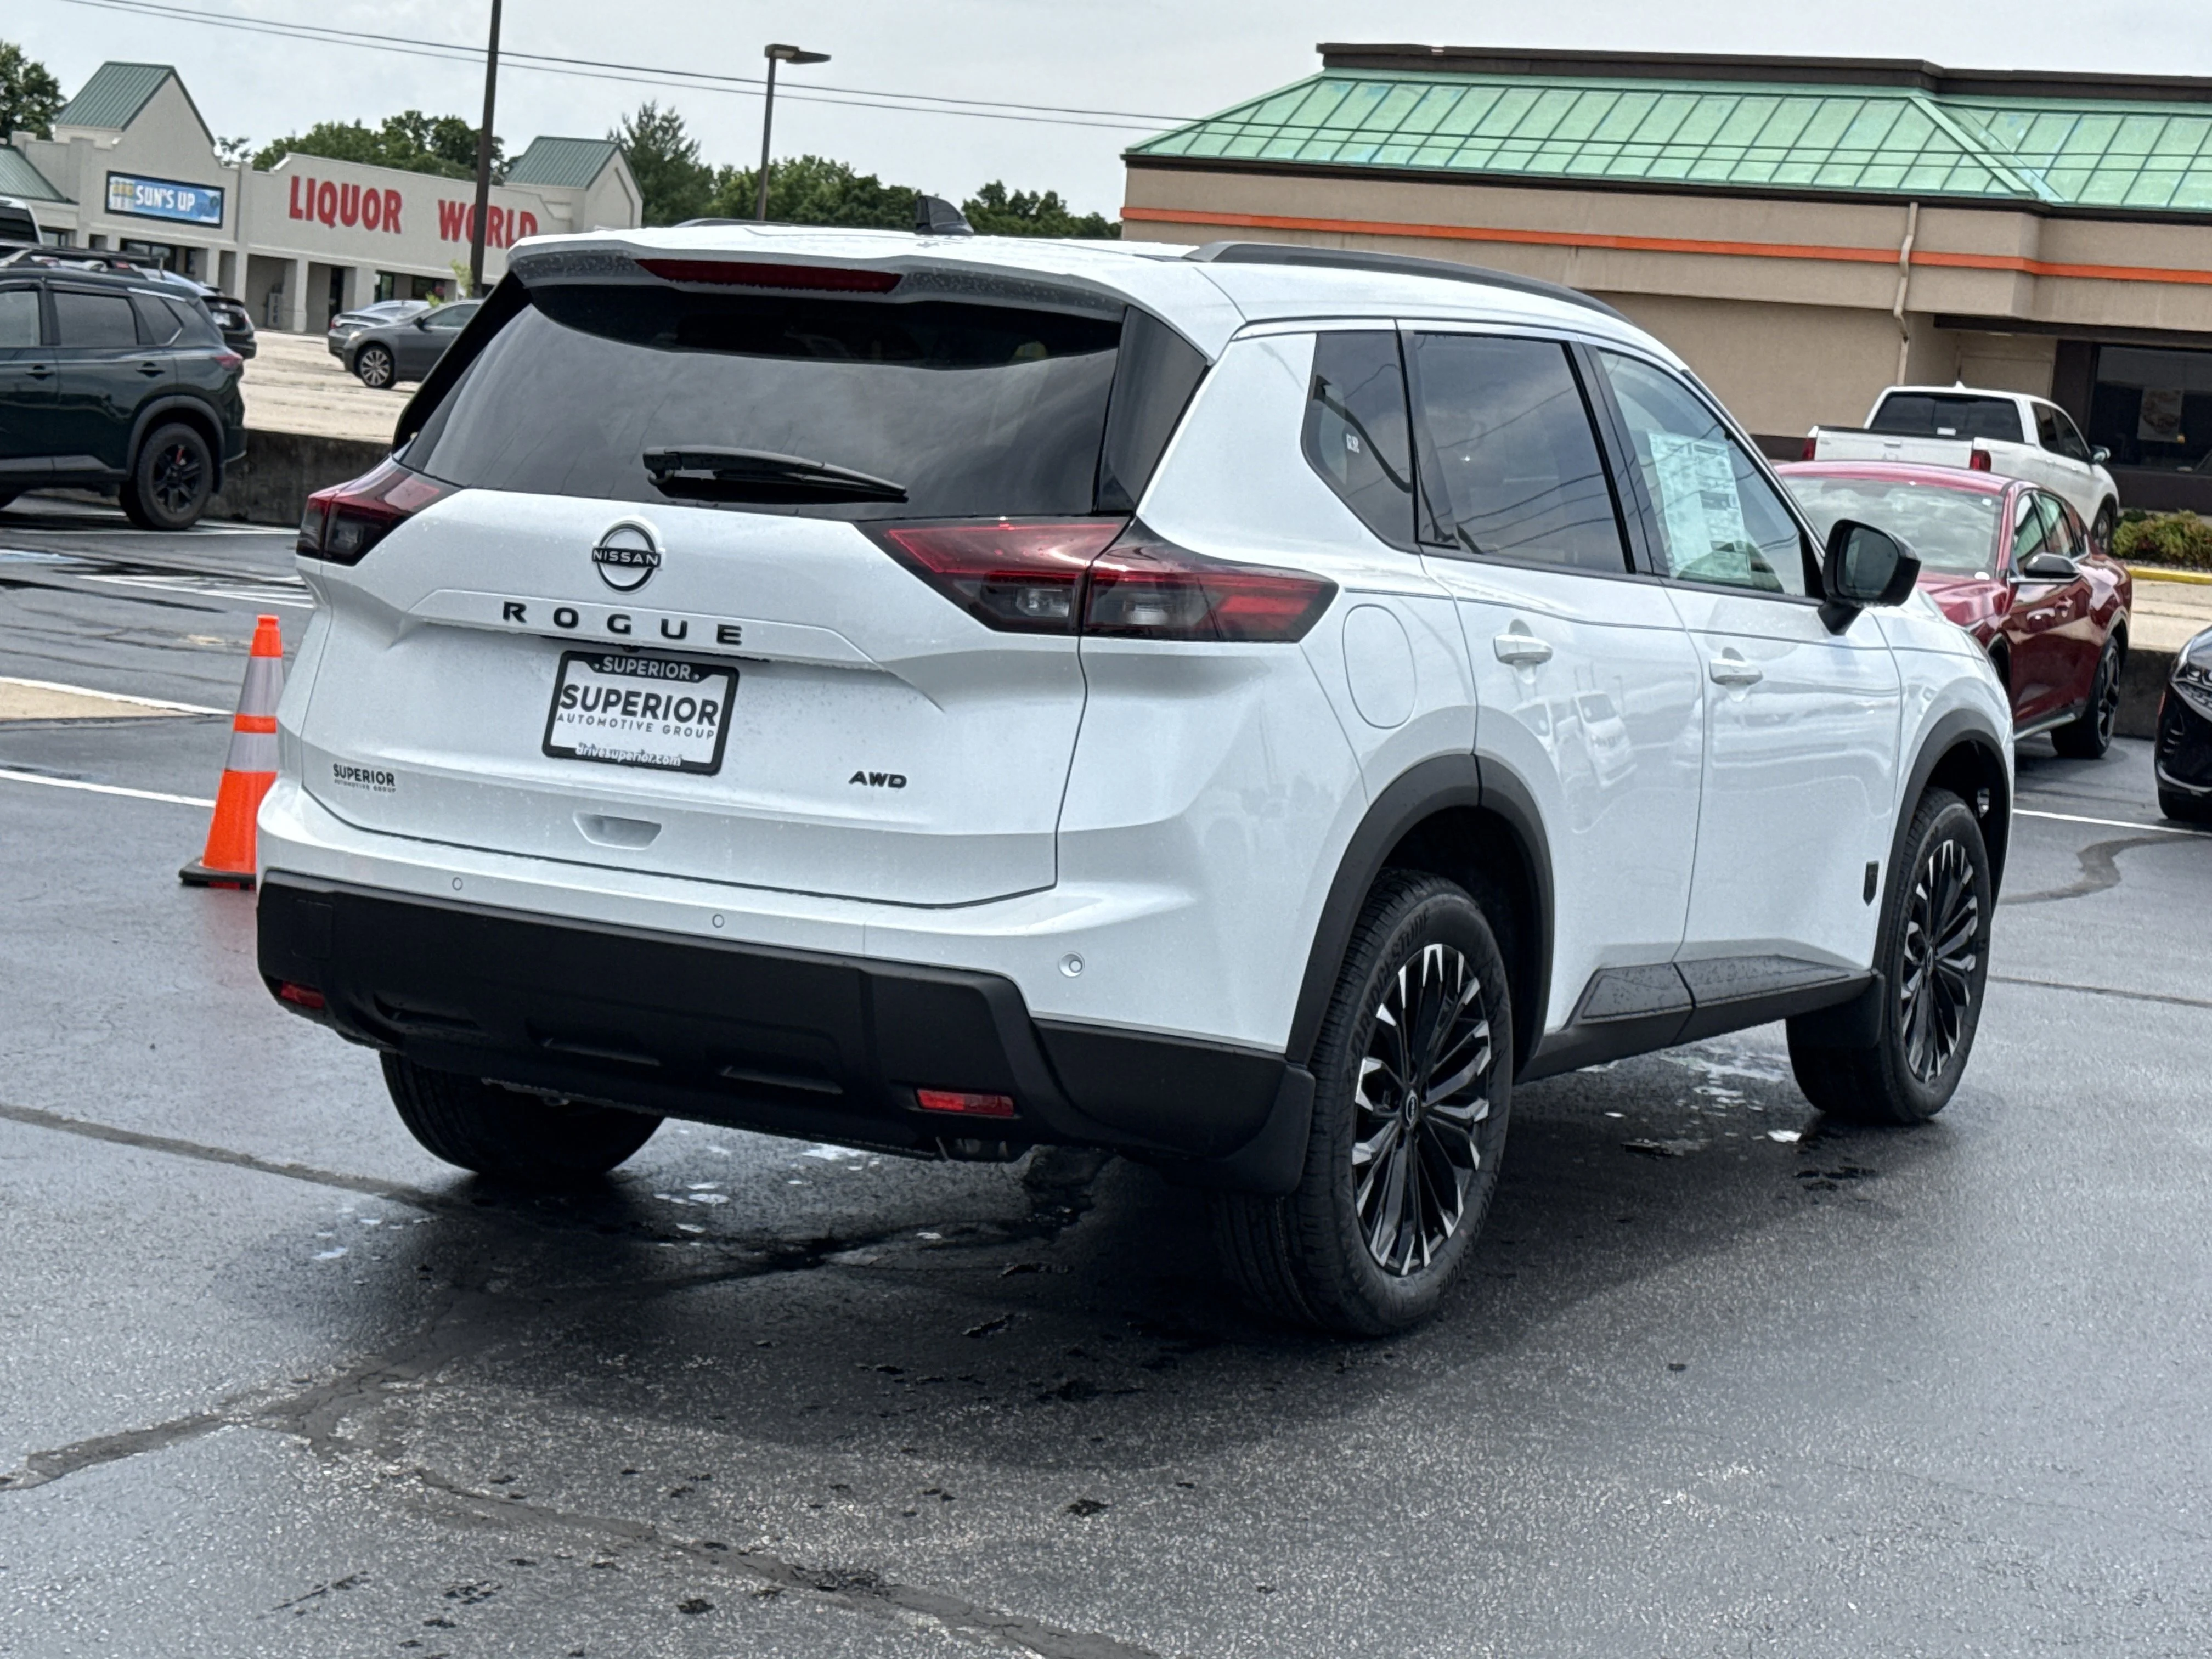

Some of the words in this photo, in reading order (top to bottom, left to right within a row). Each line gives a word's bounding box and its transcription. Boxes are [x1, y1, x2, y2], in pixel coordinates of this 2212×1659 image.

[136, 184, 174, 208] SUN'S
[177, 191, 195, 211] UP
[289, 175, 402, 234] LIQUOR
[593, 549, 658, 566] NISSAN
[503, 601, 742, 646] ROGUE
[603, 657, 691, 680] SUPERIOR
[560, 684, 719, 727] SUPERIOR
[556, 713, 653, 732] AUTOMOTIVE
[662, 724, 714, 740] GROUP
[332, 763, 396, 787] SUPERIOR
[848, 770, 907, 789] AWD
